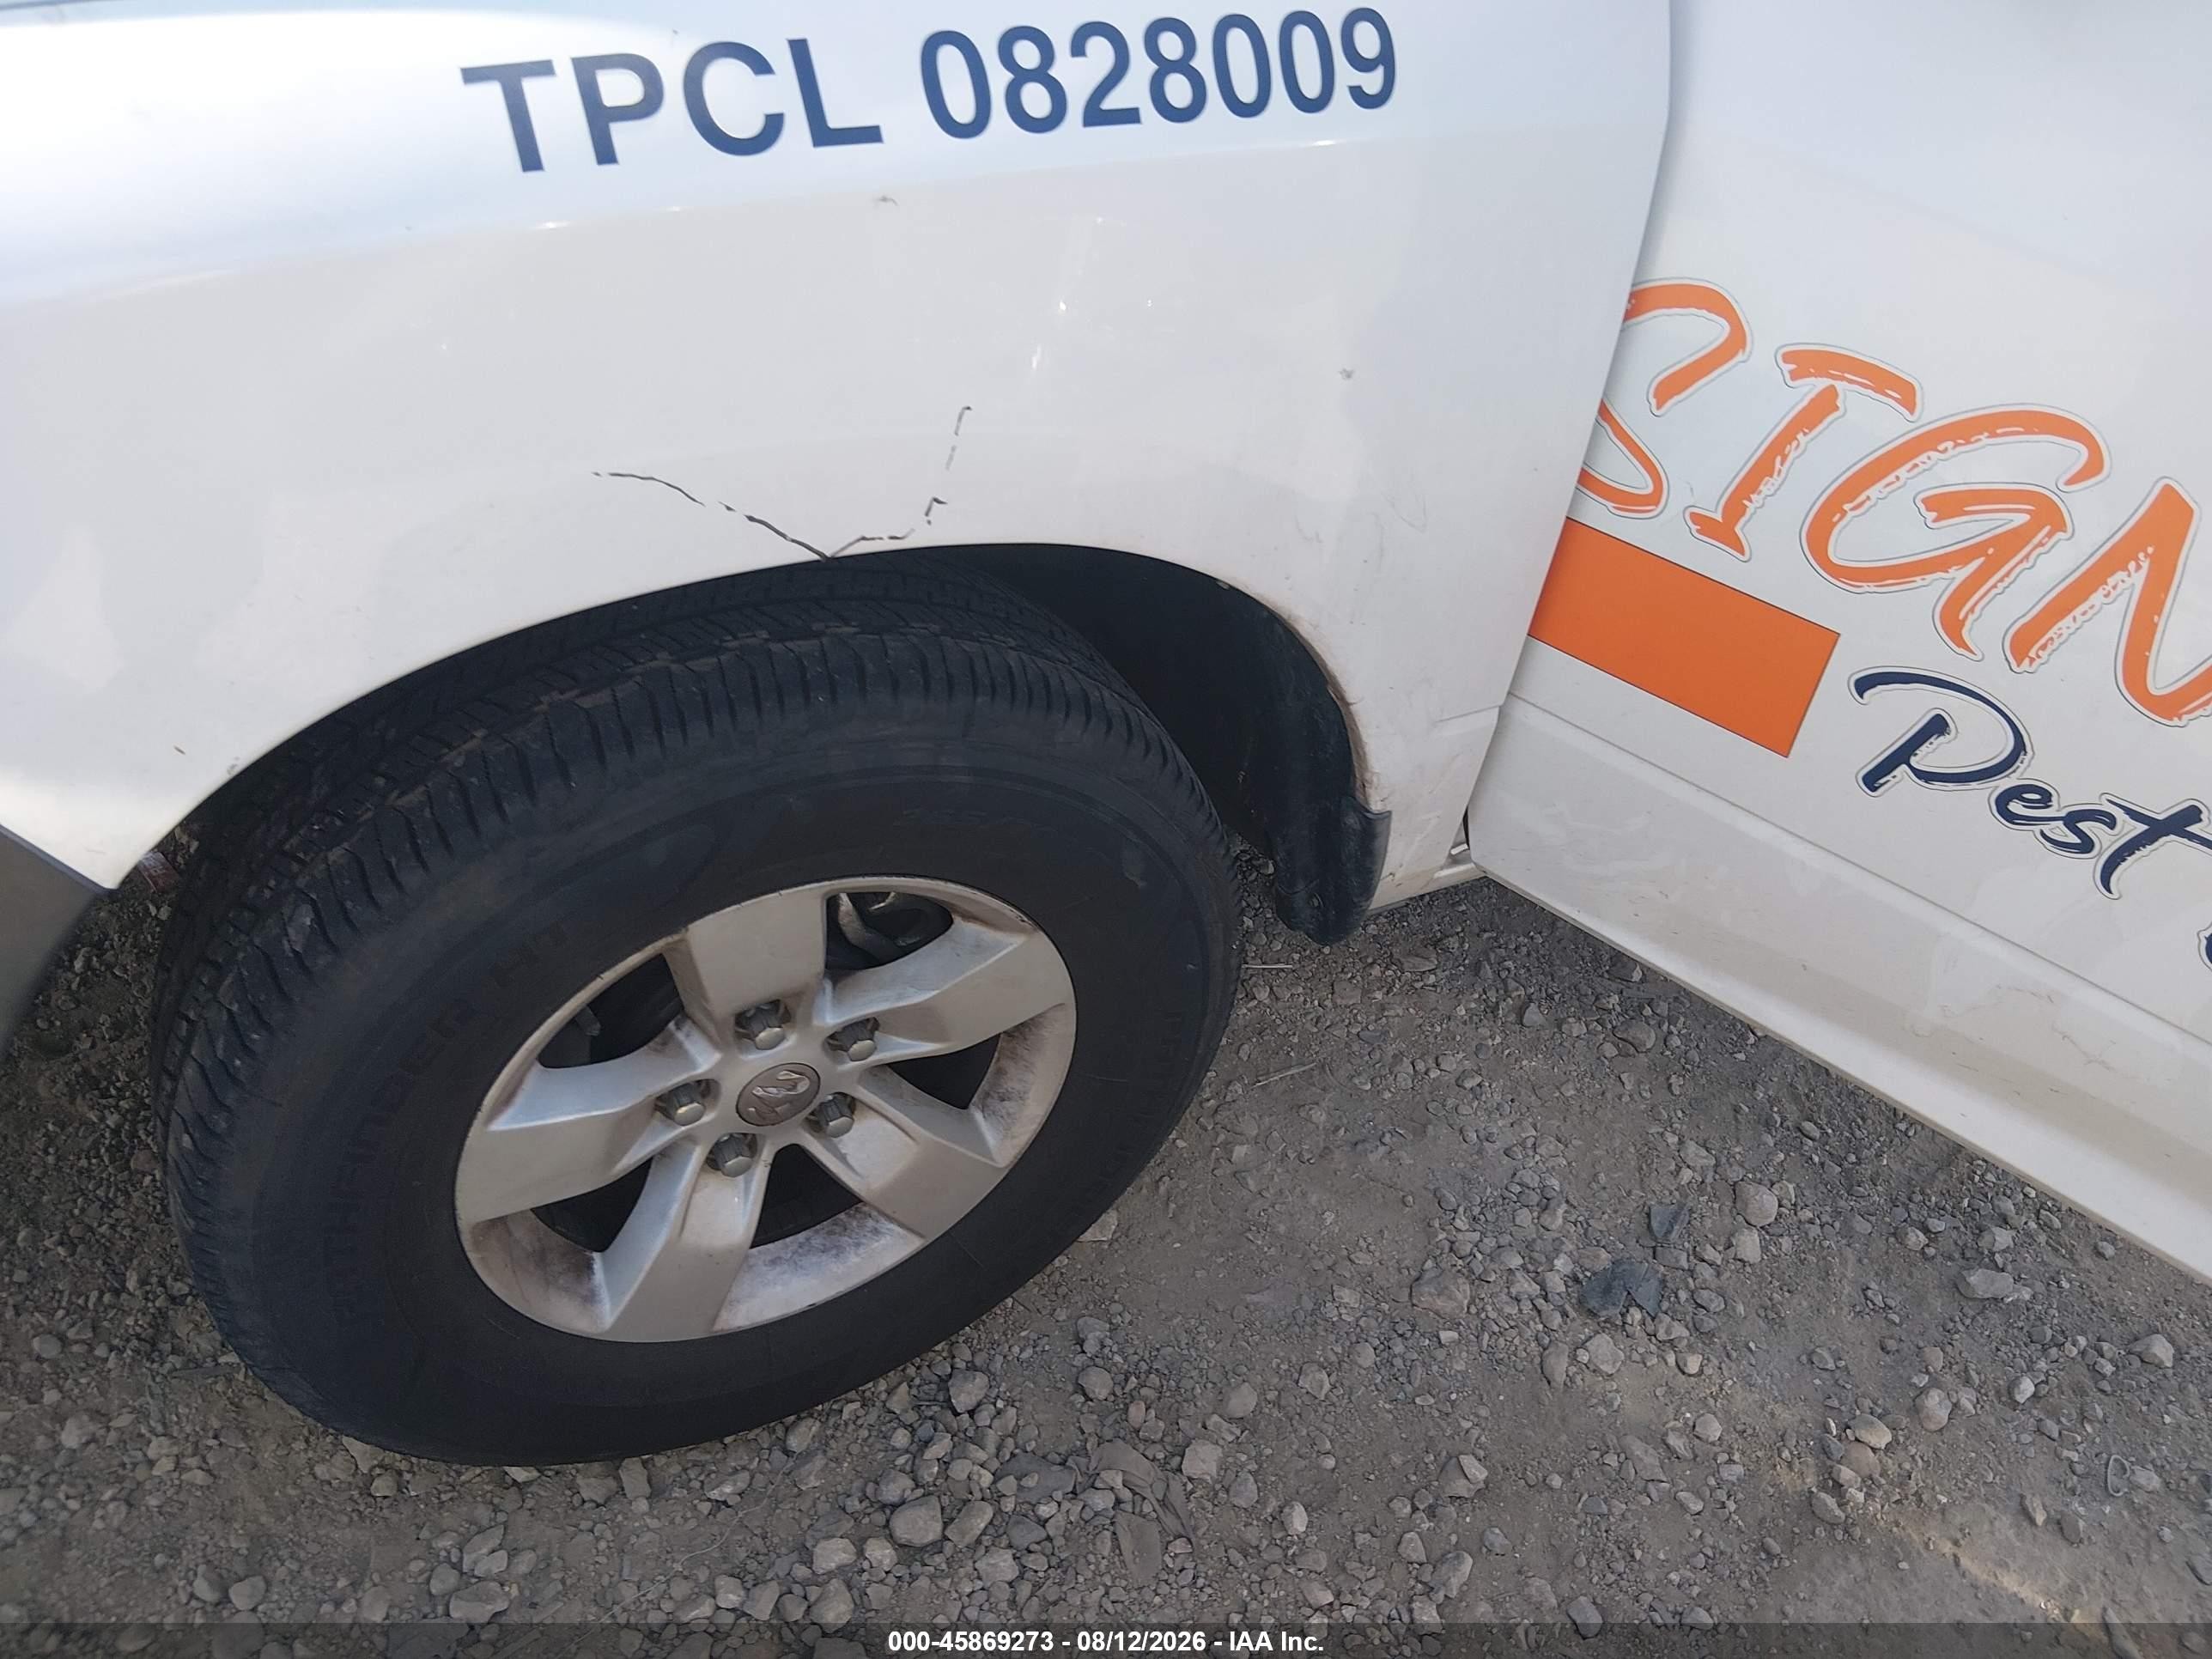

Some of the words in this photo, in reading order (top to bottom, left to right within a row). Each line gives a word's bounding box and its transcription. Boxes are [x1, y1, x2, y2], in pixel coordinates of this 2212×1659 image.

[462, 37, 885, 174] TPCL
[919, 6, 1398, 140] 0828009
[1852, 669, 2212, 897] Pest
